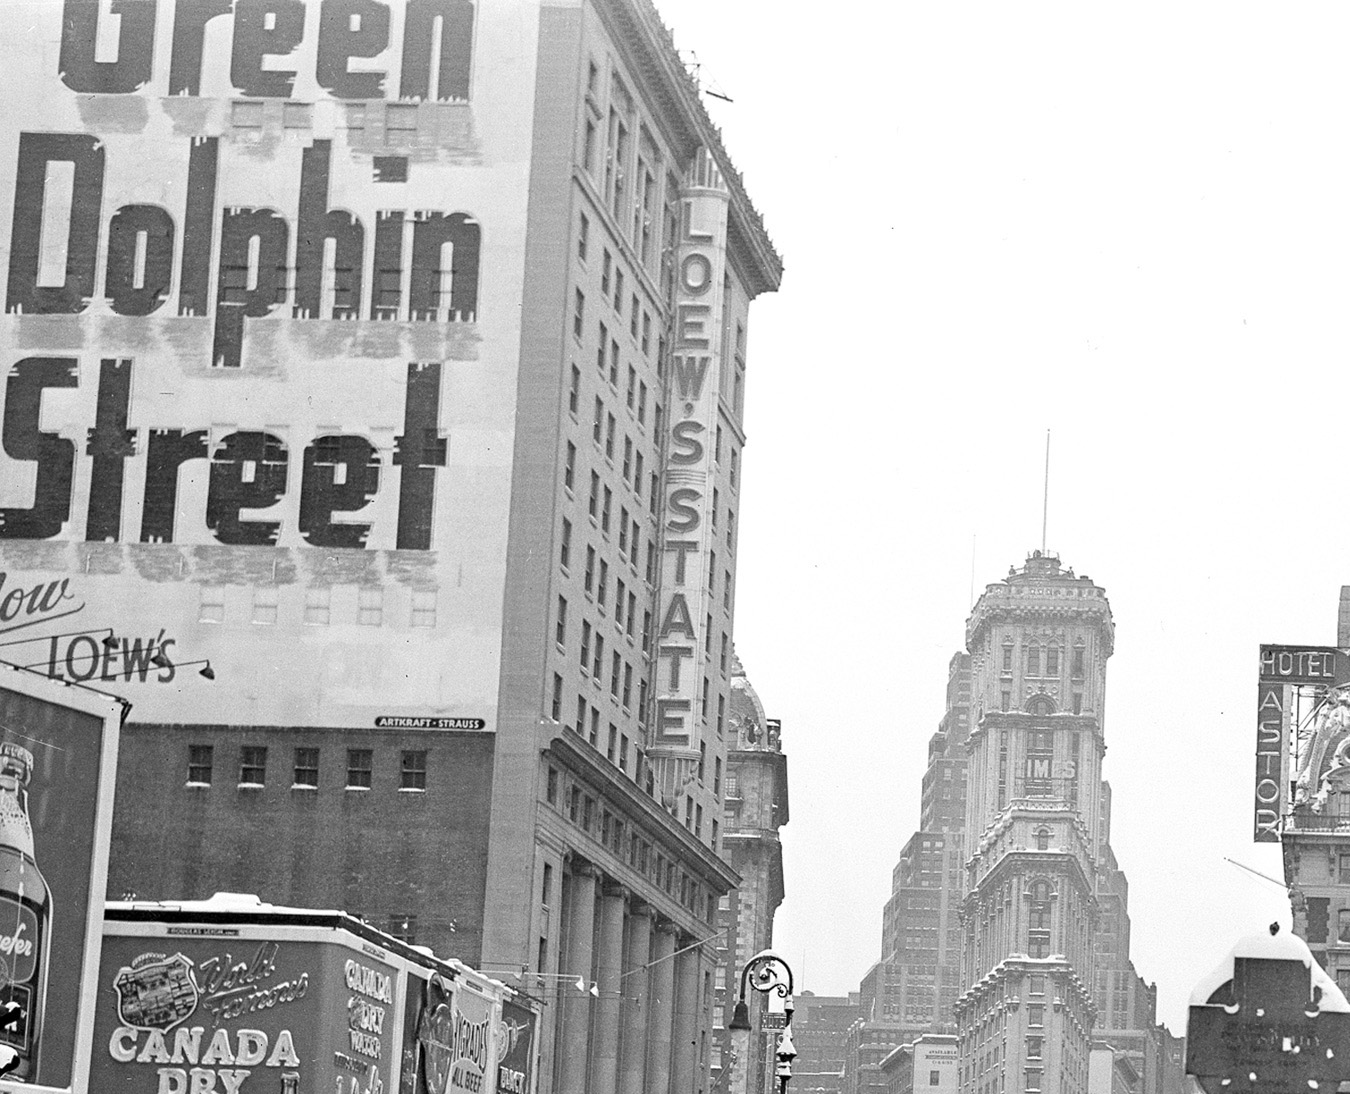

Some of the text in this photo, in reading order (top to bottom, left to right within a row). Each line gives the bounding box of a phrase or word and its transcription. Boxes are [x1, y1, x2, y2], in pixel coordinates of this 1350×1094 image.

[4, 130, 481, 368] Dolphin
[0, 355, 448, 550] Street
[655, 202, 716, 748] LOEW'S STATE
[0, 572, 75, 622] ow
[48, 628, 176, 683] LOEW'S
[1260, 650, 1335, 678] HOTEL
[379, 717, 480, 729] ARTKRAFT STRAUSS
[1256, 690, 1283, 838] ASTOR
[344, 958, 393, 1005] CANADA
[109, 1026, 300, 1067] CANADA
[452, 1066, 483, 1094] ALL BEEF
